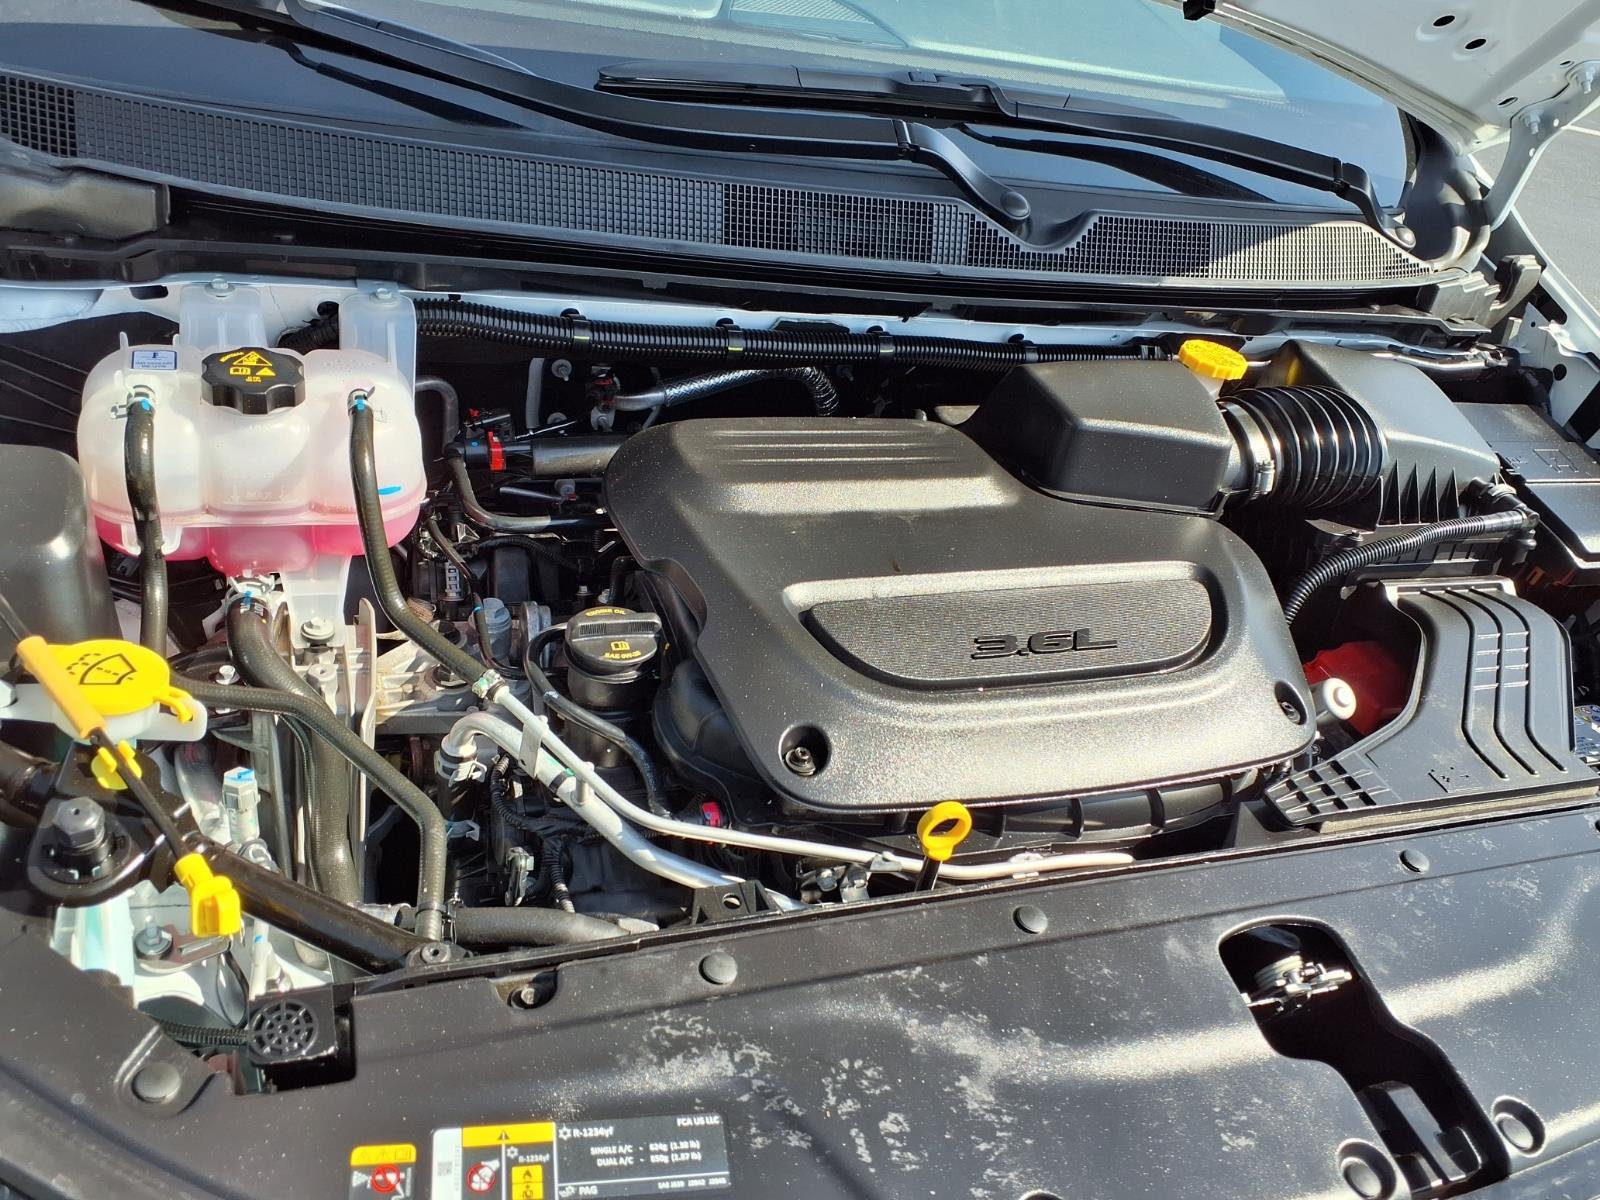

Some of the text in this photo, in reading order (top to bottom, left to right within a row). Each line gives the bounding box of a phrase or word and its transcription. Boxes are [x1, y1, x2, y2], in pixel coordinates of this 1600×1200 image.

[970, 628, 1118, 660] 3.6L
[677, 1115, 720, 1127] FCA US LLC
[573, 1126, 614, 1138] R-1234yf
[590, 1146, 617, 1156] SINGLE
[617, 1144, 633, 1155] A/C
[519, 1153, 549, 1163] R-1234yf
[597, 1157, 618, 1167] DUAL
[618, 1156, 634, 1166] A/C
[579, 1185, 598, 1196] PAG
